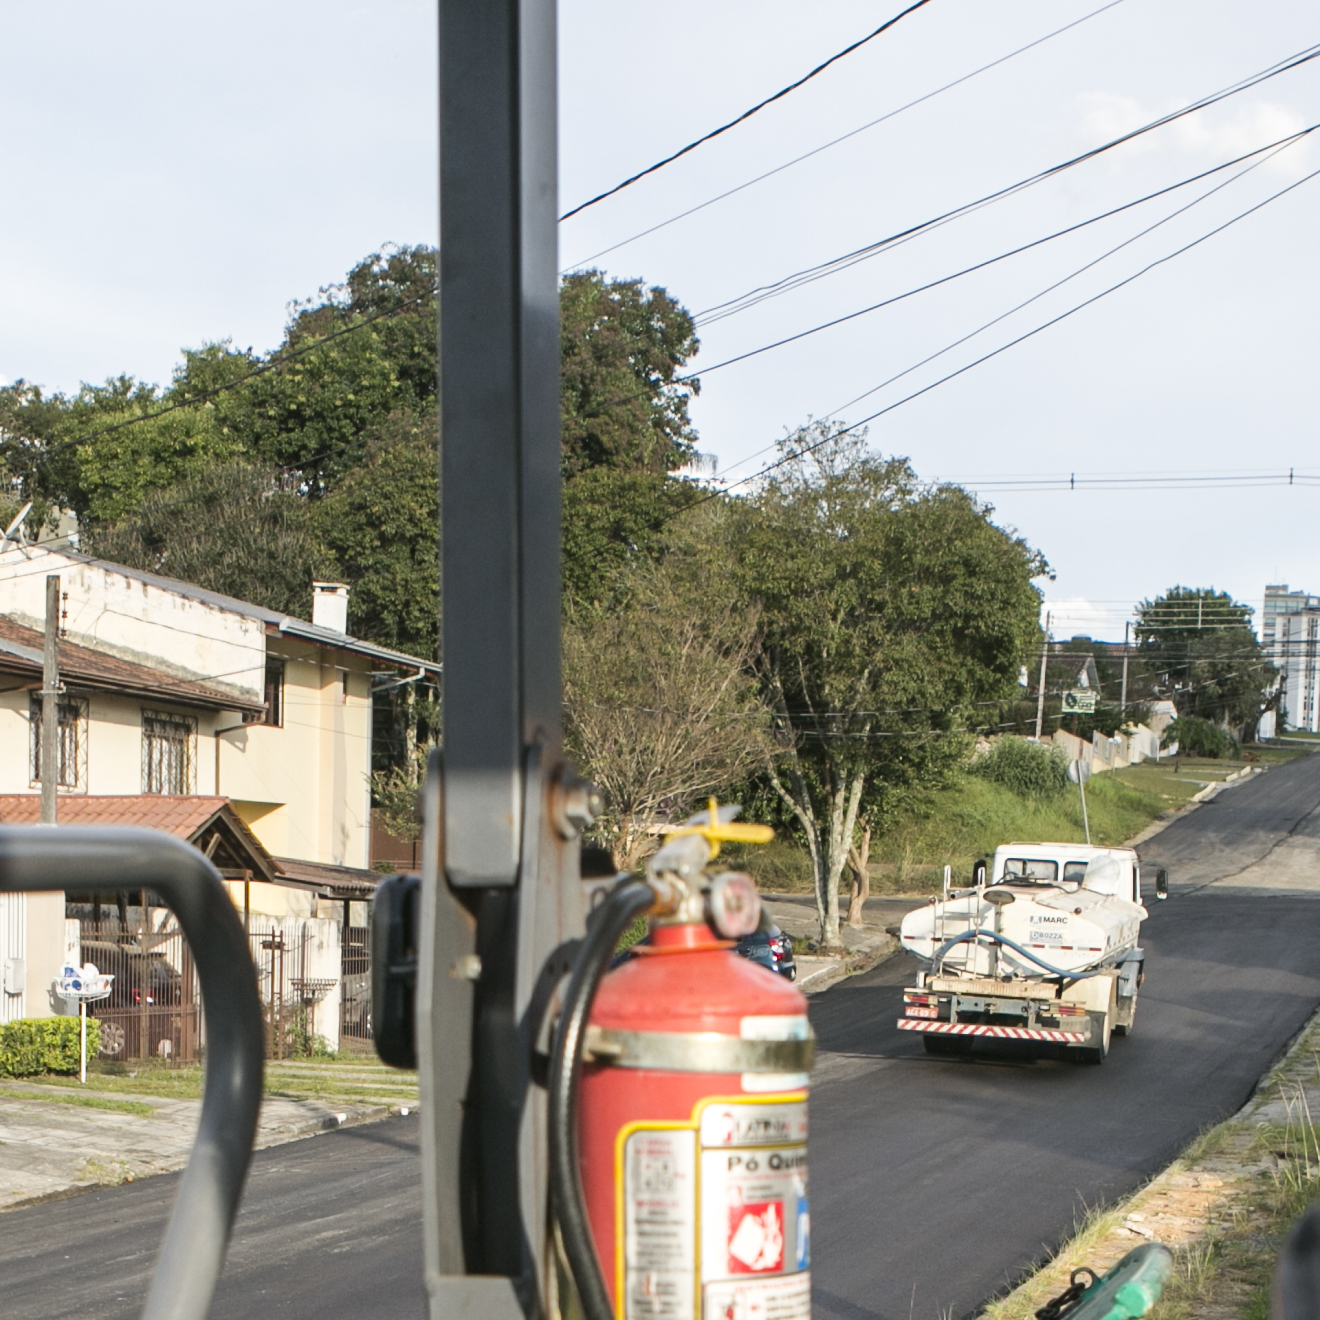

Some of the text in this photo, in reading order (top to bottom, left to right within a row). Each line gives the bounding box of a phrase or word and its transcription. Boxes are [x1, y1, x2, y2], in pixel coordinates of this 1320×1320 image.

[1043, 916, 1068, 925] MARC
[1039, 932, 1063, 940] BOZZA
[727, 1155, 759, 1172] Pó
